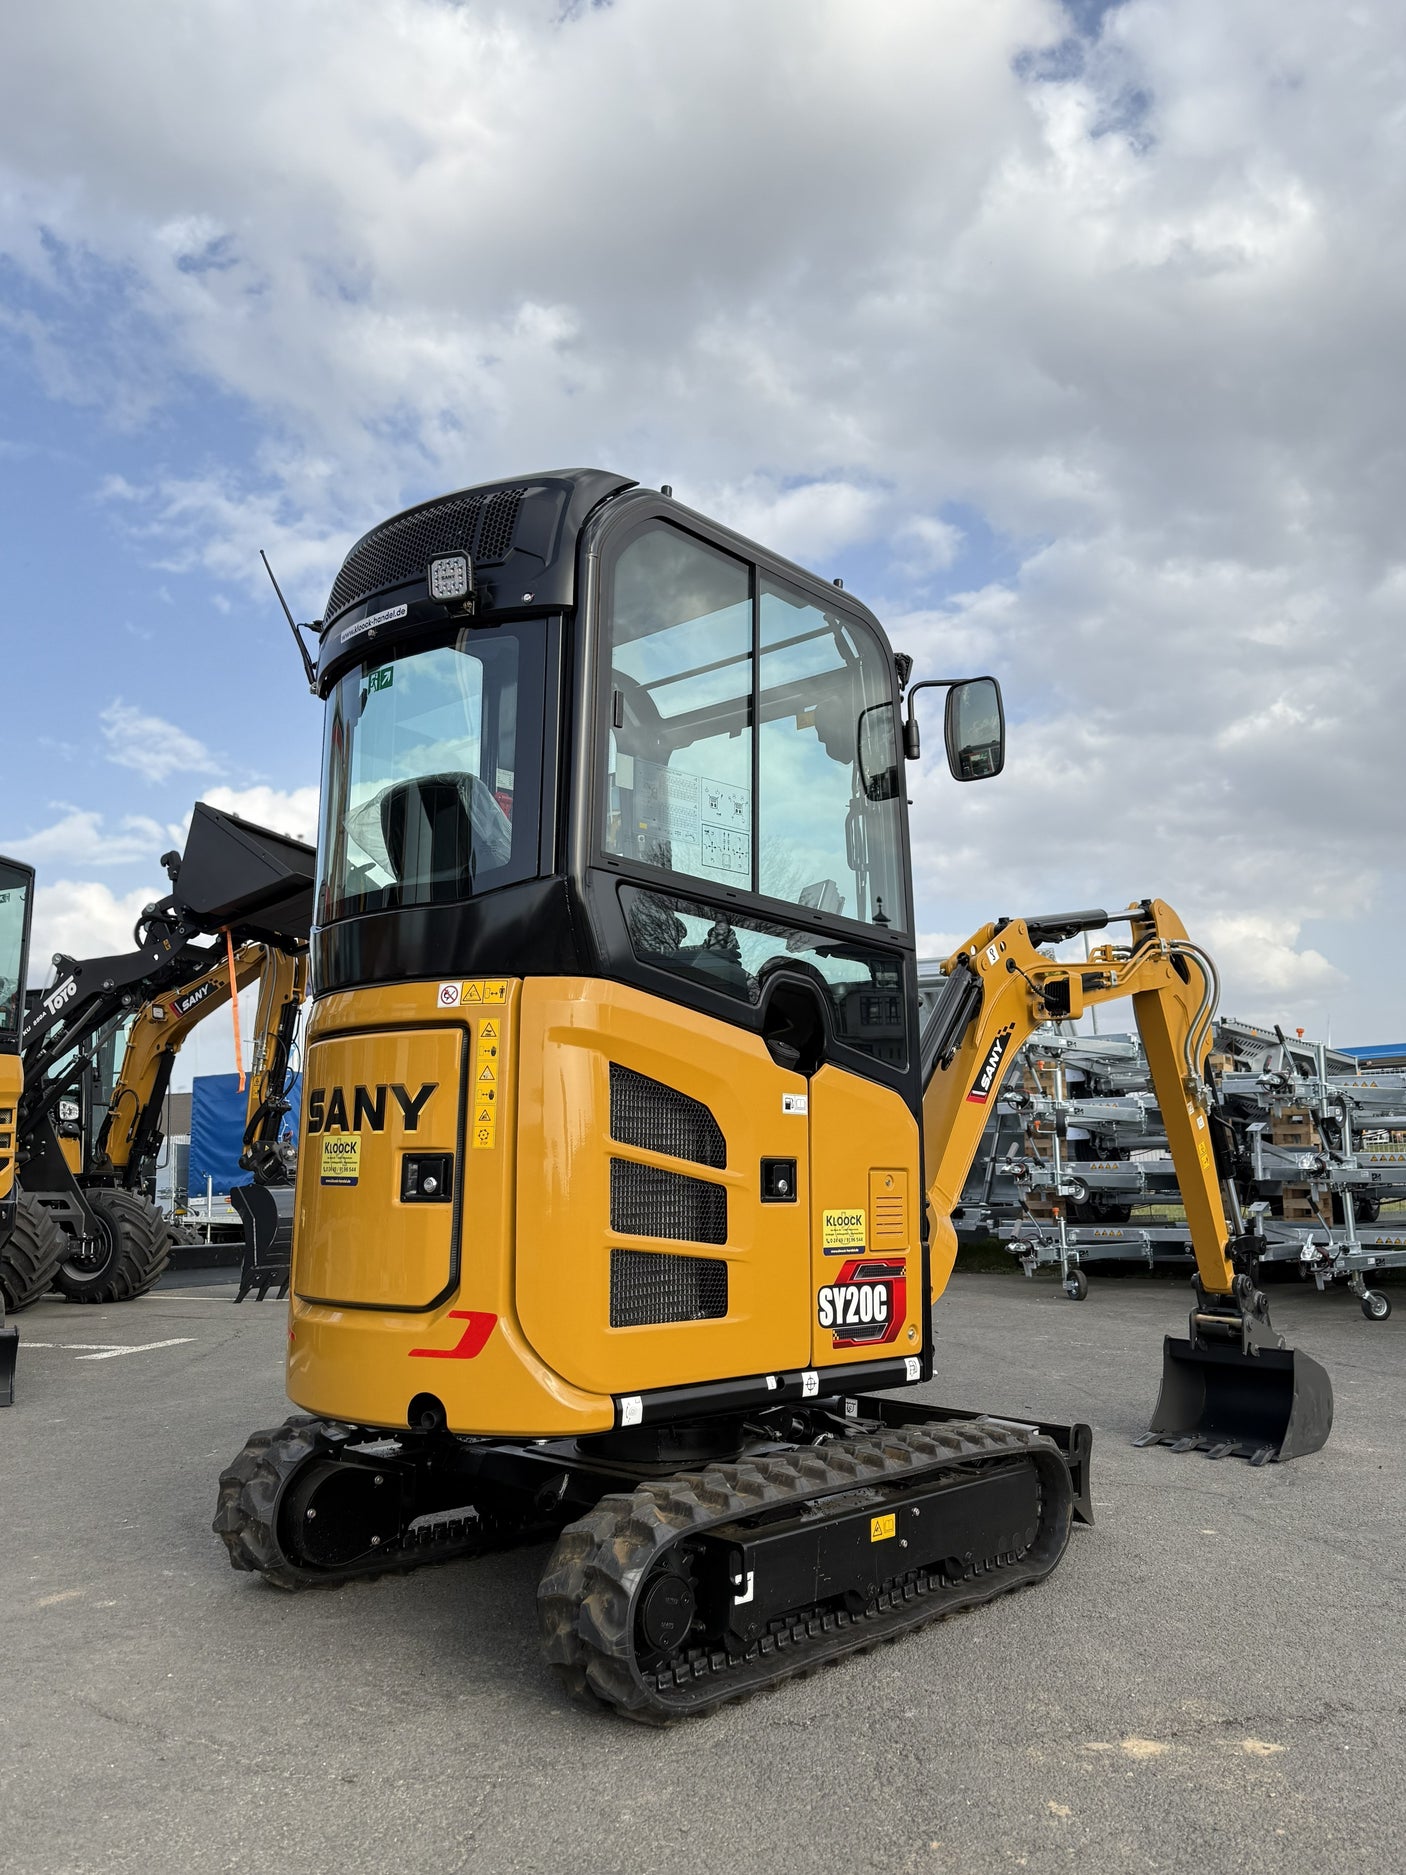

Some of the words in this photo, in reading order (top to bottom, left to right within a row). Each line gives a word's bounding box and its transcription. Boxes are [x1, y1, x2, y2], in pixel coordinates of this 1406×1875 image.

[341, 607, 406, 640] www.kloock-handel.de
[43, 975, 77, 1015] TOYO
[182, 983, 209, 1011] SANY
[981, 1038, 1003, 1092] SANY
[308, 1083, 439, 1135] SANY
[325, 1141, 357, 1154] KLOOCK
[826, 1215, 862, 1227] KLOOCK
[819, 1284, 887, 1326] SY20C
